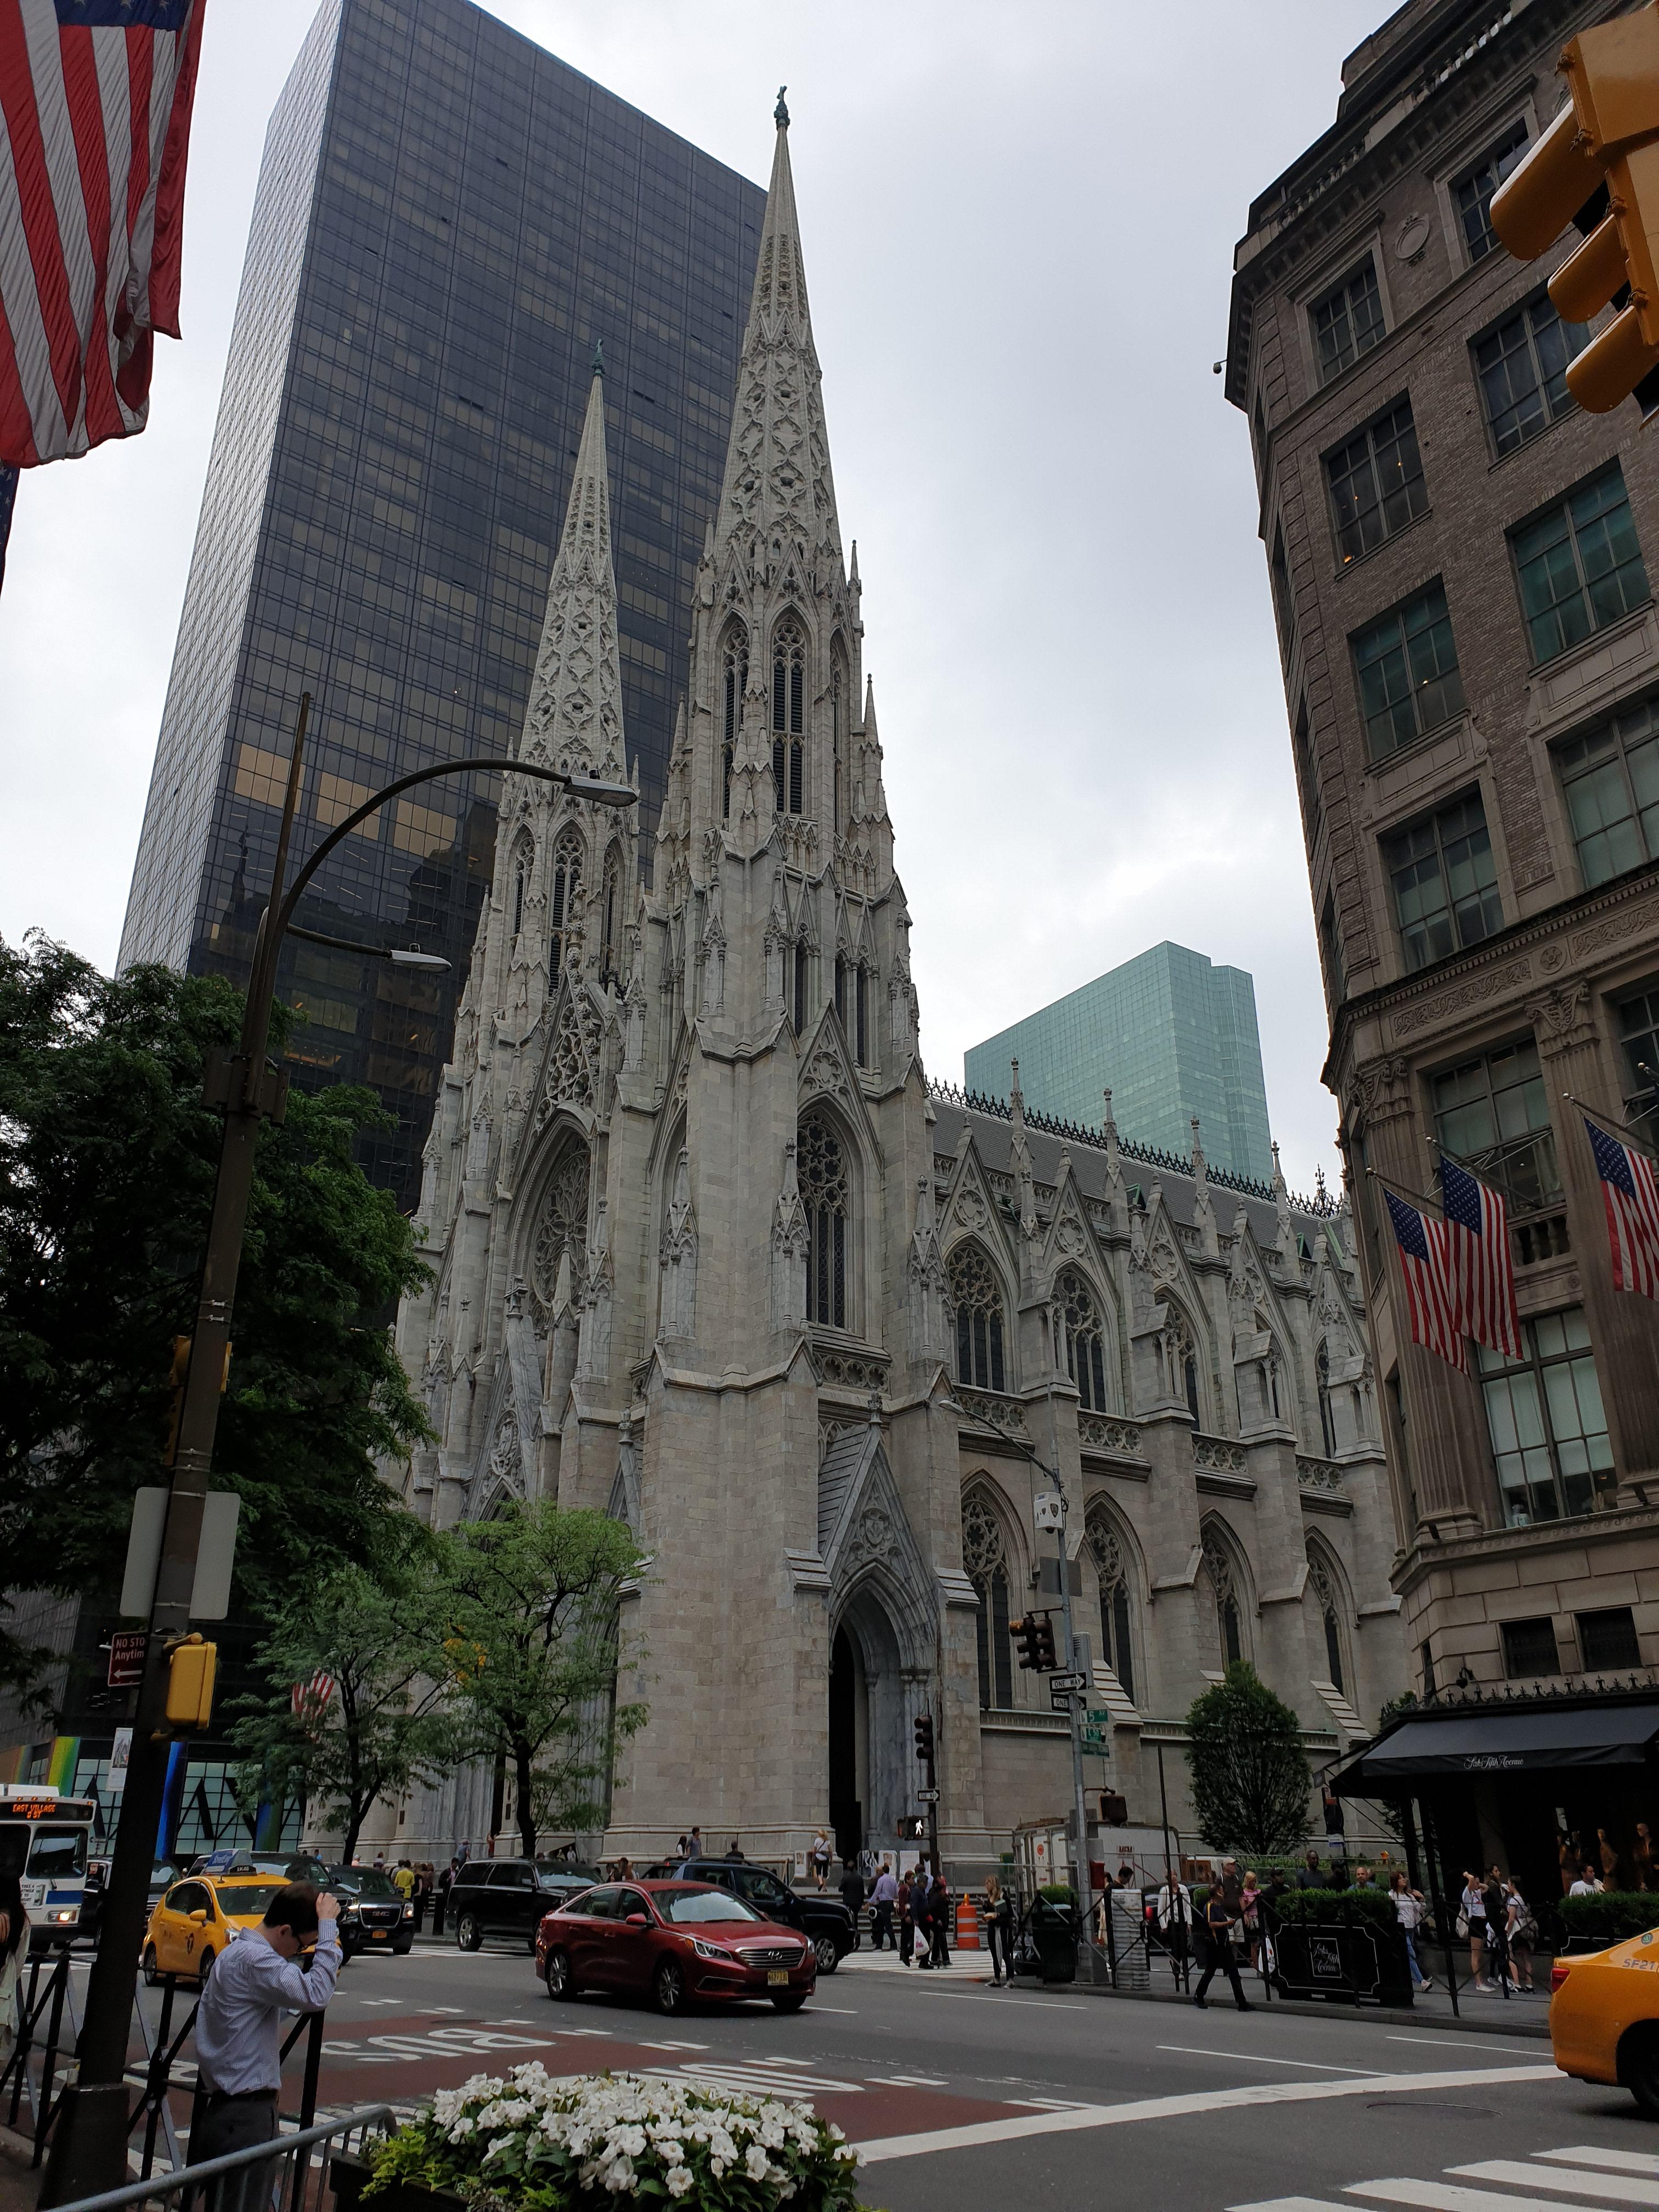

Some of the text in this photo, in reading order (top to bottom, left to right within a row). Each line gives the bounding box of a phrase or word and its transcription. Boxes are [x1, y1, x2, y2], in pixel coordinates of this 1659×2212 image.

[116, 1638, 128, 1649] NO
[1054, 1678, 1081, 1688] ONE WAY
[1056, 1699, 1066, 1707] ONE
[1089, 1711, 1095, 1722] 5
[1463, 1755, 1523, 1769] Saks Fifth Avenue
[13, 1804, 56, 1812] EAST VILLAGE
[1622, 1958, 1655, 1970] SF21
